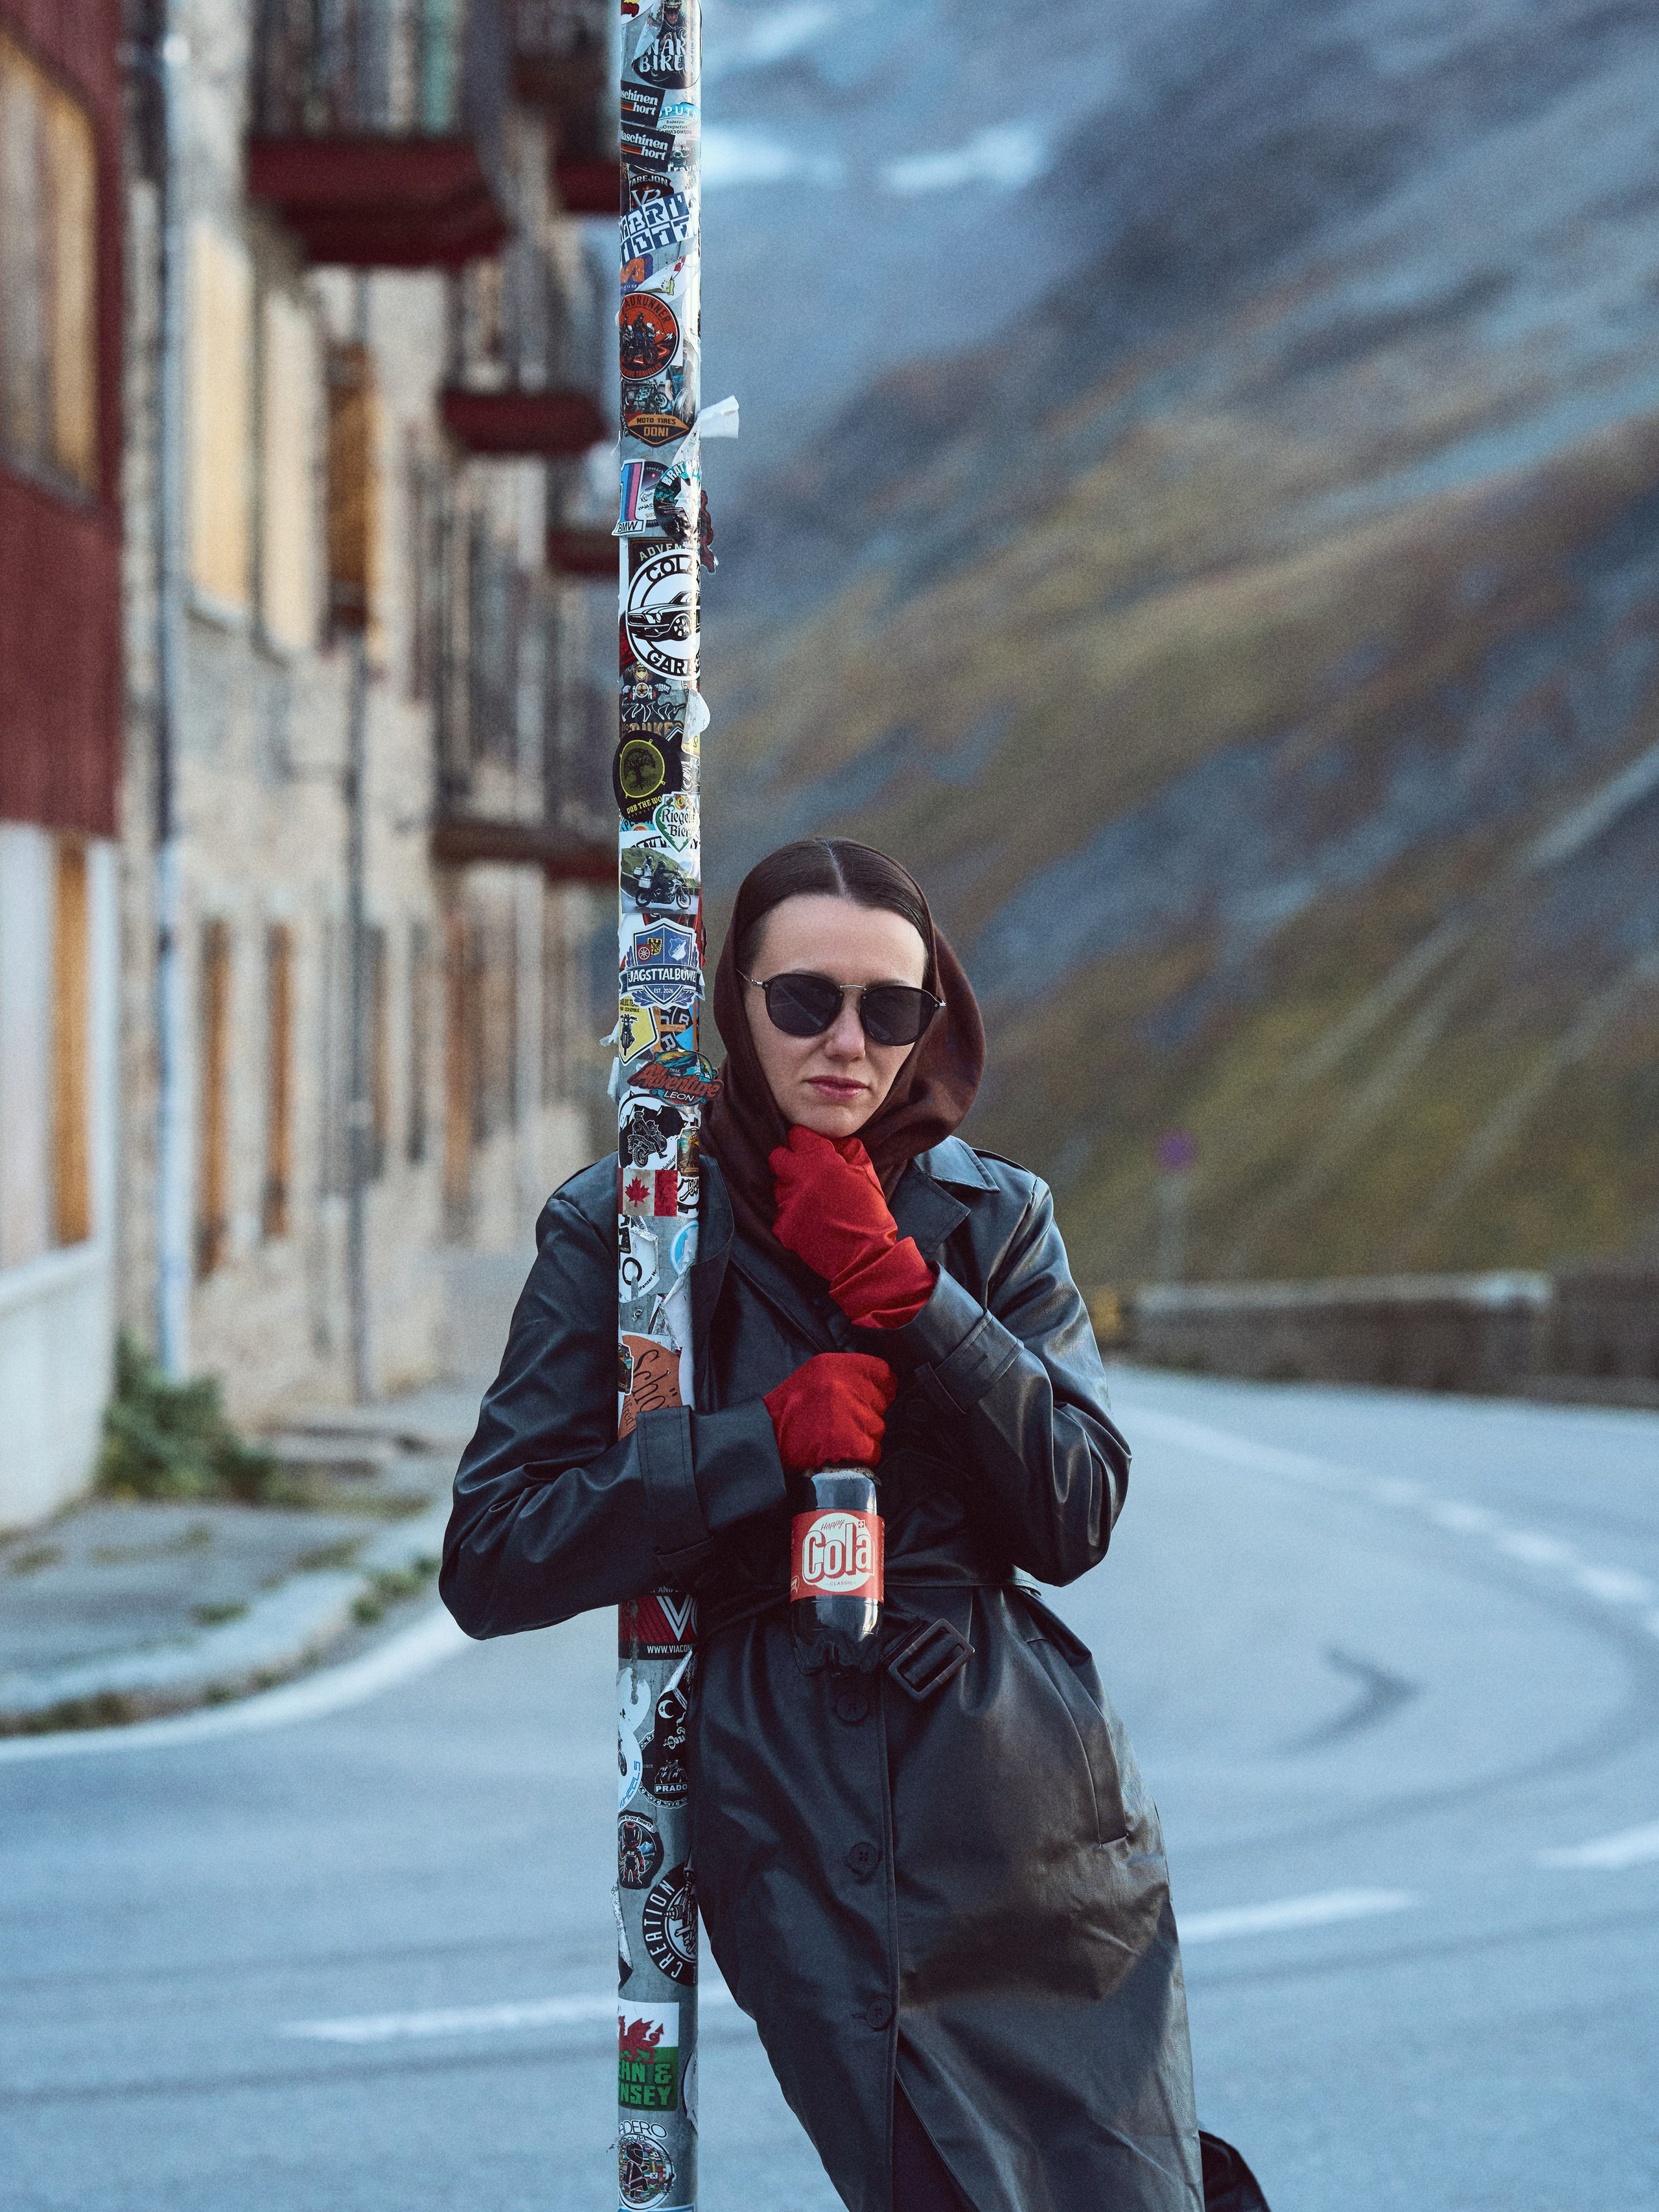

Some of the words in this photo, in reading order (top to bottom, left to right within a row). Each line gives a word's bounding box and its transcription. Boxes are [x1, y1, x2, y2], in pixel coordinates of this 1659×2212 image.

[621, 89, 658, 106] schinen
[632, 102, 656, 116] hort
[642, 145, 667, 161] hort
[644, 426, 669, 437] DONI
[618, 520, 638, 533] BMW
[626, 804, 638, 815] DUB
[638, 799, 652, 809] THE
[667, 824, 690, 837] Bier
[635, 1063, 721, 1098] Adventure
[664, 1091, 695, 1102] LEON
[622, 1397, 636, 1426] lfred
[820, 1519, 845, 1531] Happy
[804, 1522, 874, 1581] Cola
[655, 1784, 688, 1793] PRADO
[638, 1817, 652, 1828] hearts
[644, 1880, 683, 1979] CREATION
[619, 2083, 671, 2106] NSEY
